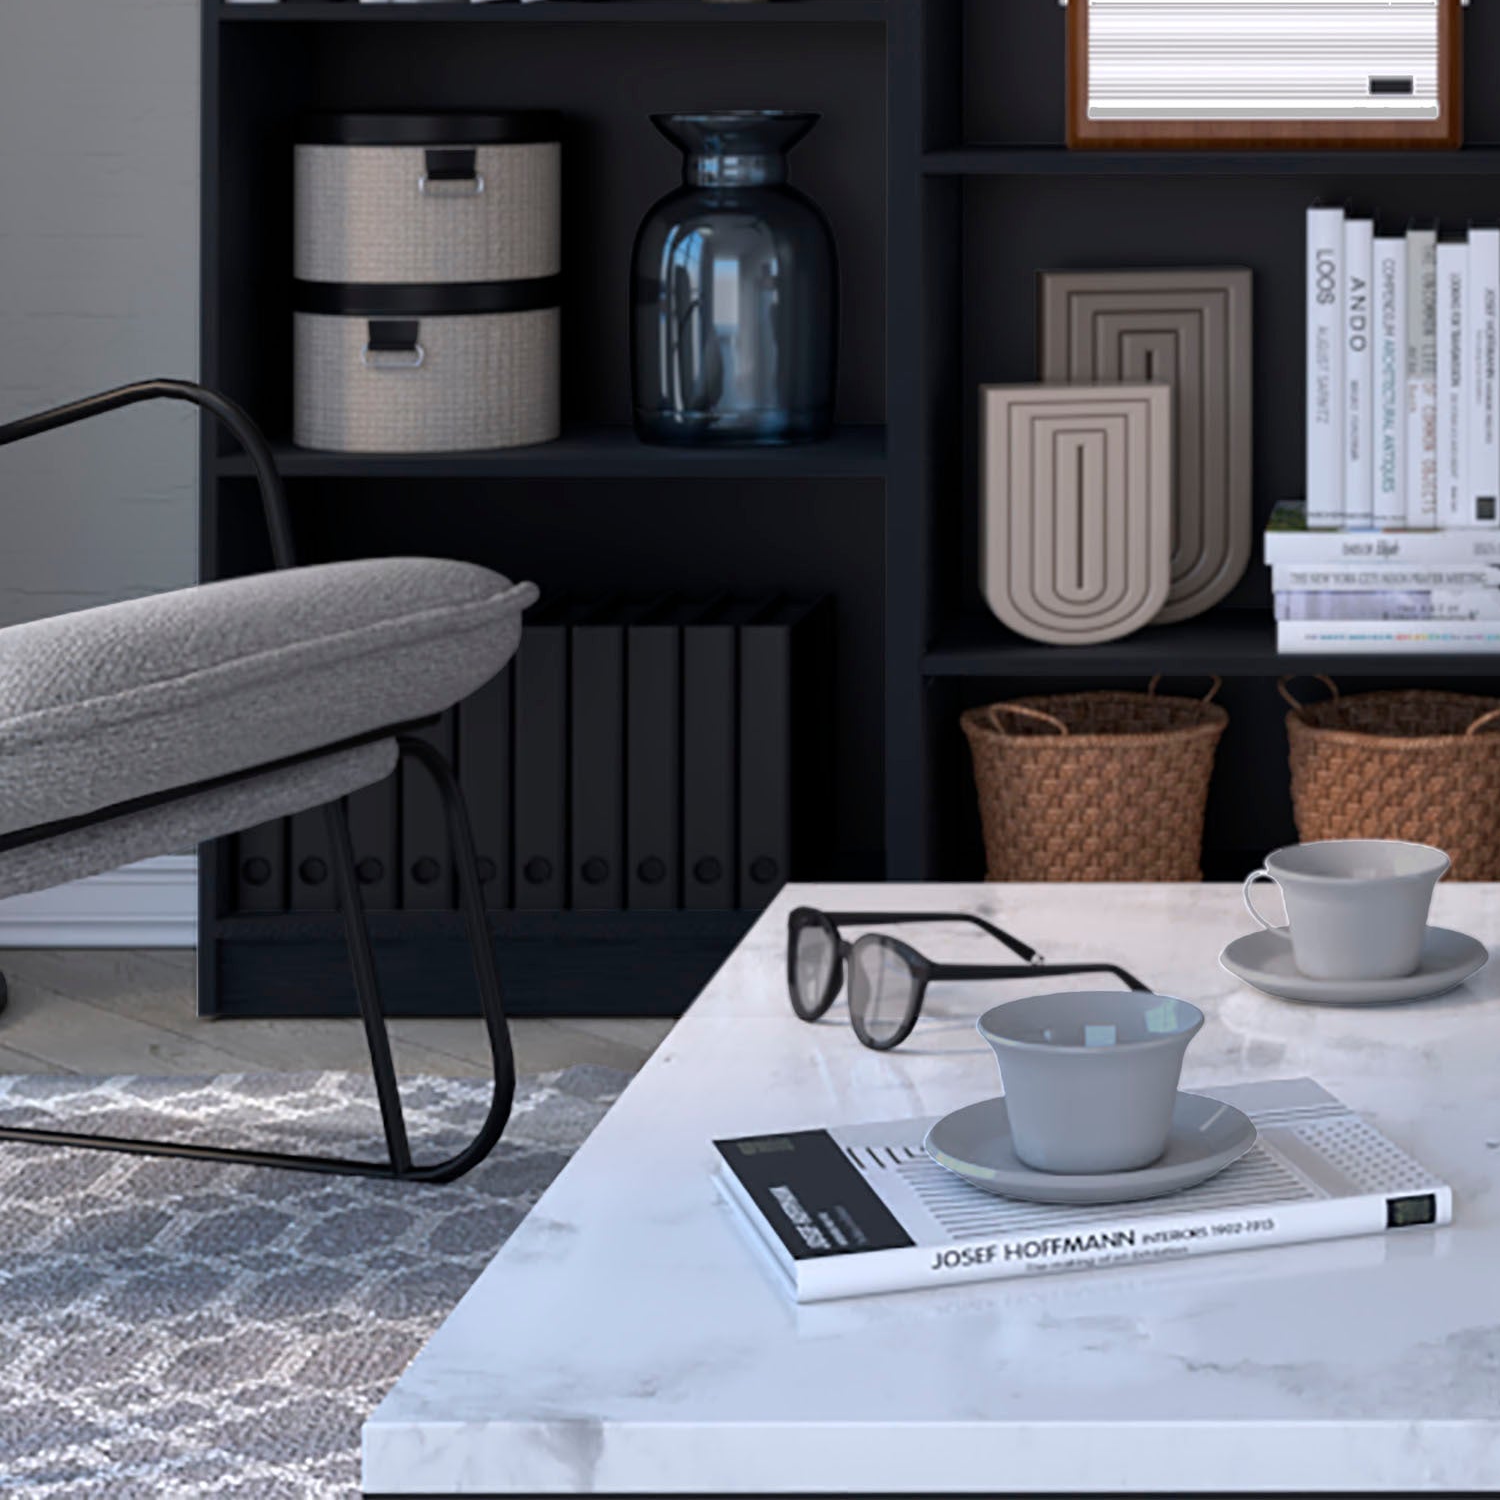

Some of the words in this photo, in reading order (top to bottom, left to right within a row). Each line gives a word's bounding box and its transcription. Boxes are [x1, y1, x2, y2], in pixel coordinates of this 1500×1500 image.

[1316, 249, 1336, 305] LOOS
[1349, 276, 1367, 352] ANDO
[931, 1246, 997, 1270] JOSEF
[1004, 1229, 1136, 1263] HOFFMANN
[1141, 1226, 1208, 1245] INTERIORS
